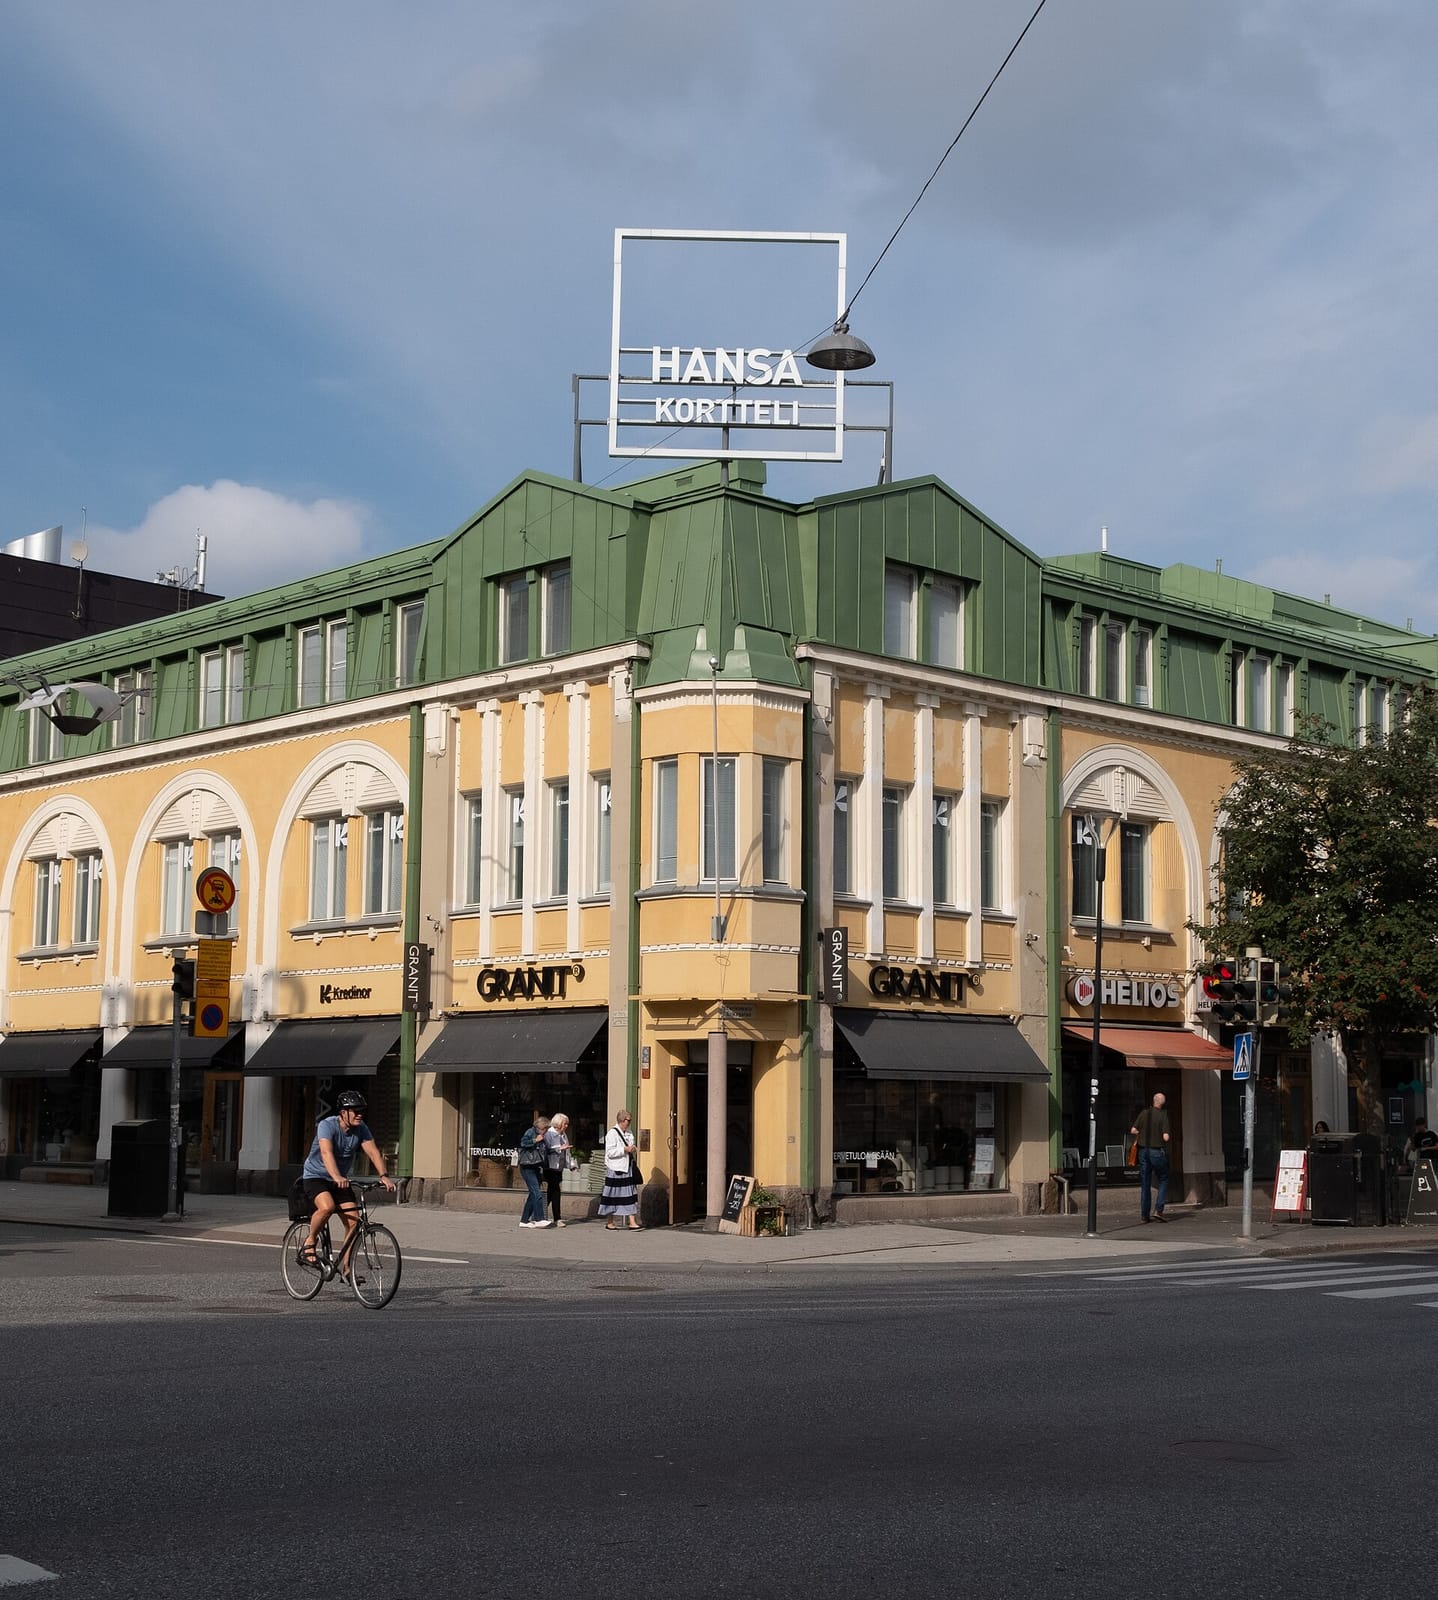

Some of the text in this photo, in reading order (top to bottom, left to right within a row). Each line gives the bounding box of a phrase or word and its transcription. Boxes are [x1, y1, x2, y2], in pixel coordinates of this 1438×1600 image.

[652, 346, 802, 385] HANSA
[655, 397, 799, 425] KORTTELI
[1101, 979, 1180, 1008] HELIOS
[470, 1147, 505, 1157] TERVETULOA
